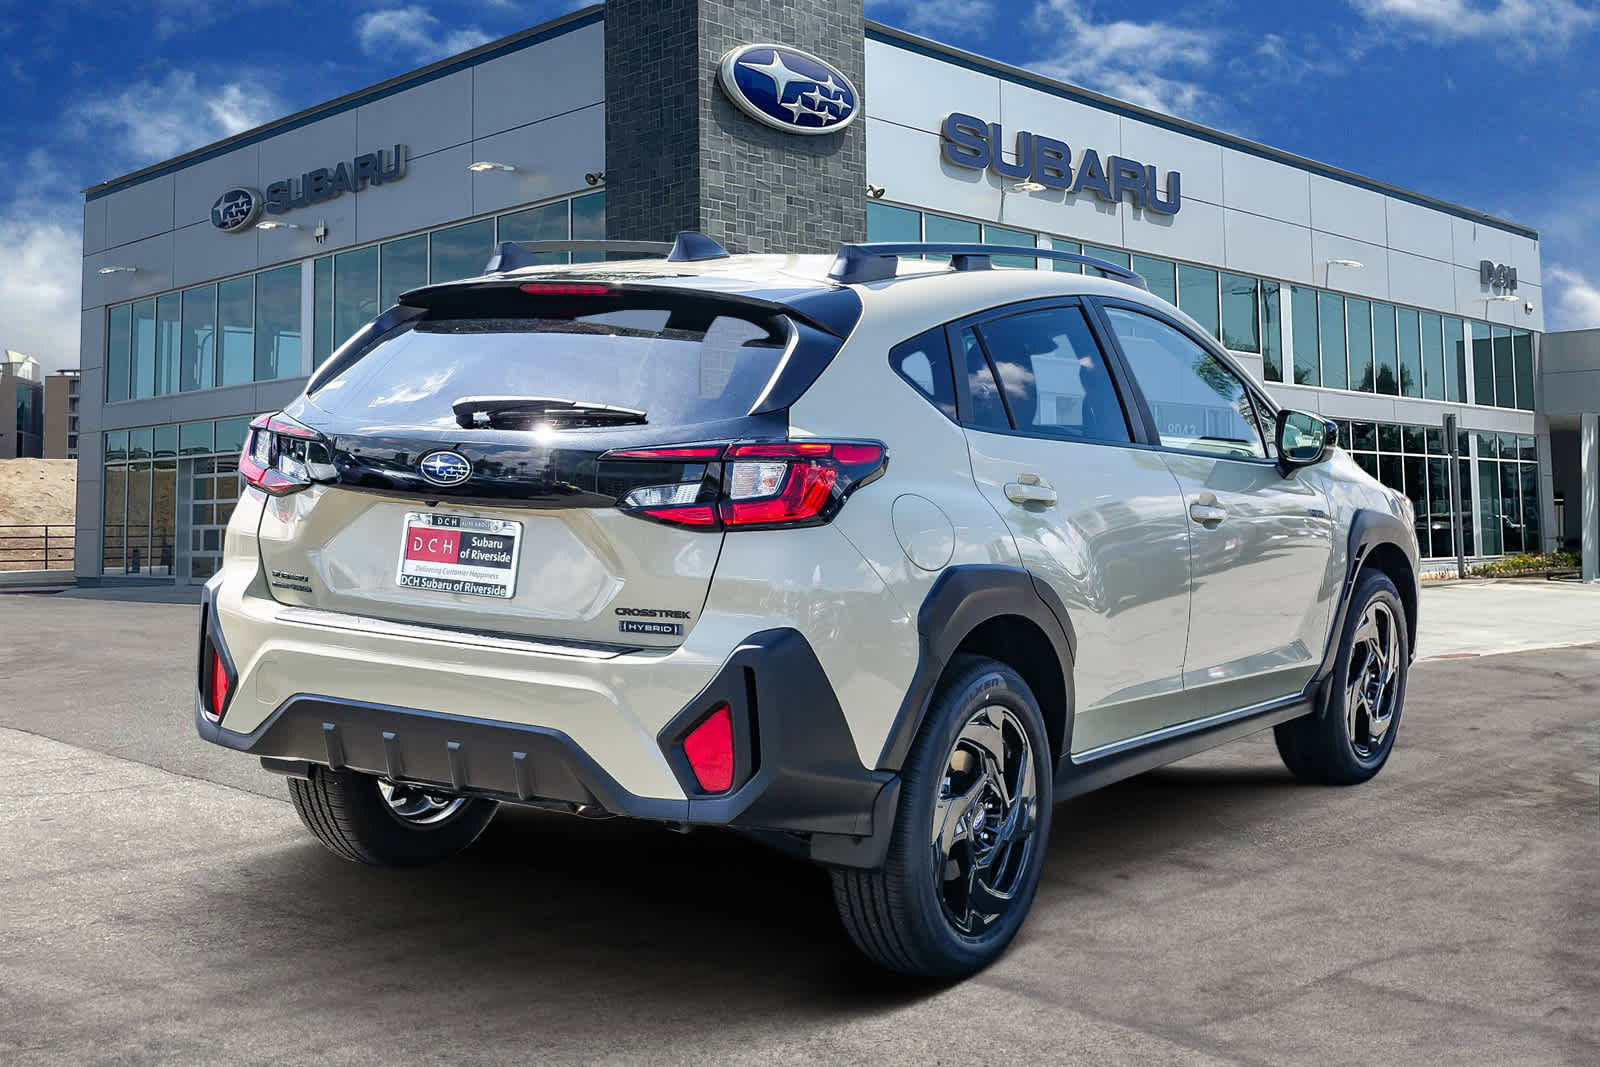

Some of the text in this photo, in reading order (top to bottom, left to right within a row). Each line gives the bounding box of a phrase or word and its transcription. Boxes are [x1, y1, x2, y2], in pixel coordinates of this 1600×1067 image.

[941, 112, 1181, 215] SUBARU
[265, 144, 407, 213] SUBARU
[437, 517, 458, 526] DCH
[413, 536, 454, 554] DCH
[471, 536, 503, 549] Subaru
[460, 549, 511, 563] of Riverside
[401, 575, 506, 596] DCH Subaru of Riverside
[614, 607, 691, 619] CROSSTREK
[628, 624, 673, 633] HYBRID
